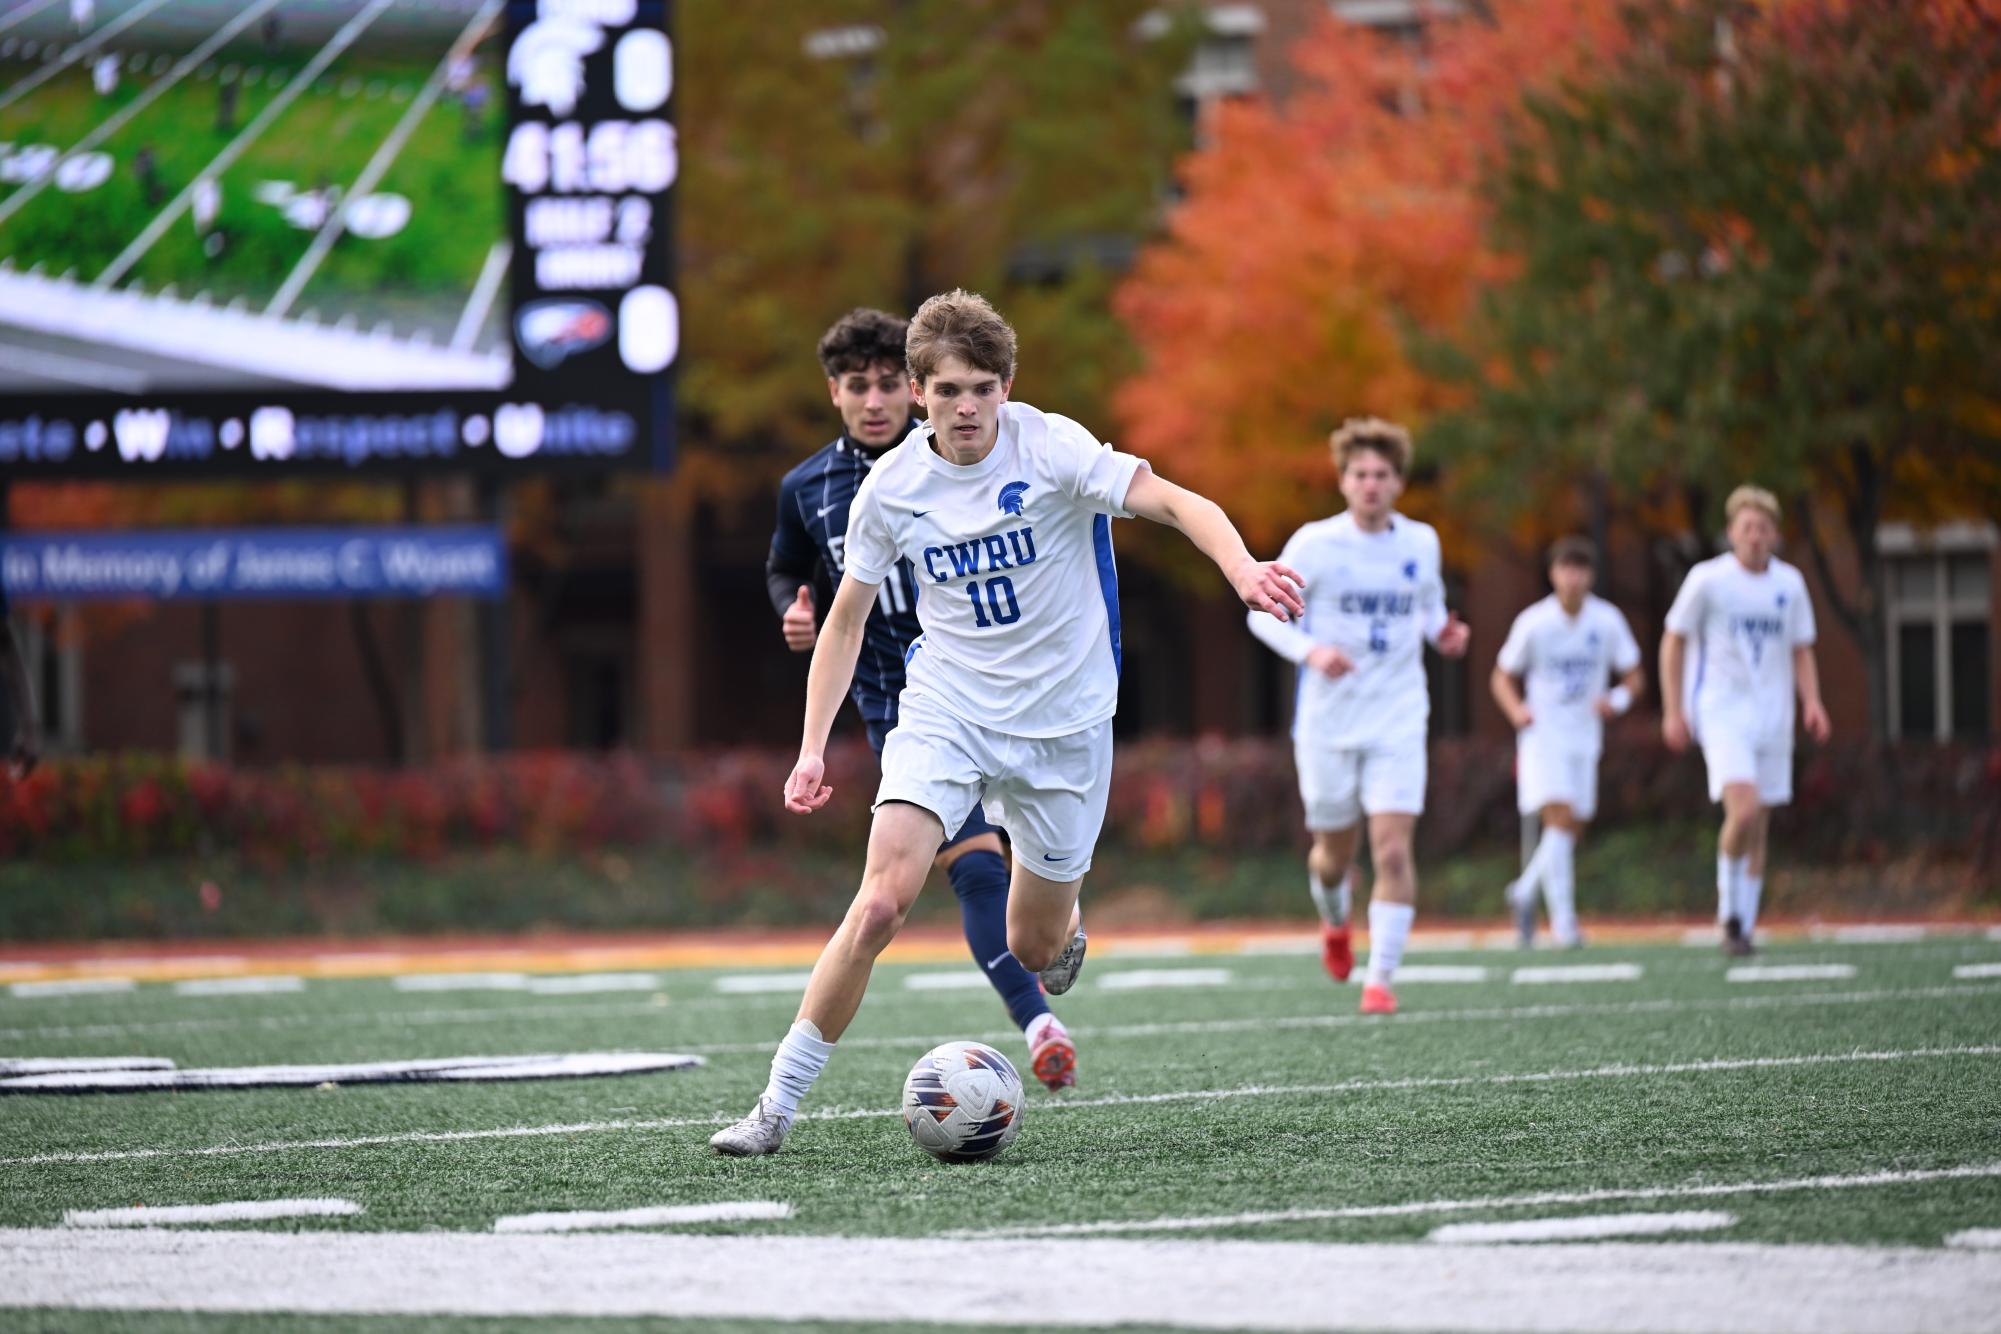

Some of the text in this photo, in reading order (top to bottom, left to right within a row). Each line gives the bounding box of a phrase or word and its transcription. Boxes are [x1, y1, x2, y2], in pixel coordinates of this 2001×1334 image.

[250, 405, 457, 467] Respect
[493, 402, 636, 459] Unite
[42, 544, 181, 597] Memory
[187, 541, 231, 590] of
[234, 542, 334, 590] James
[923, 526, 1037, 583] CWRU
[966, 575, 1021, 628] 10
[1339, 590, 1413, 617] CWRU
